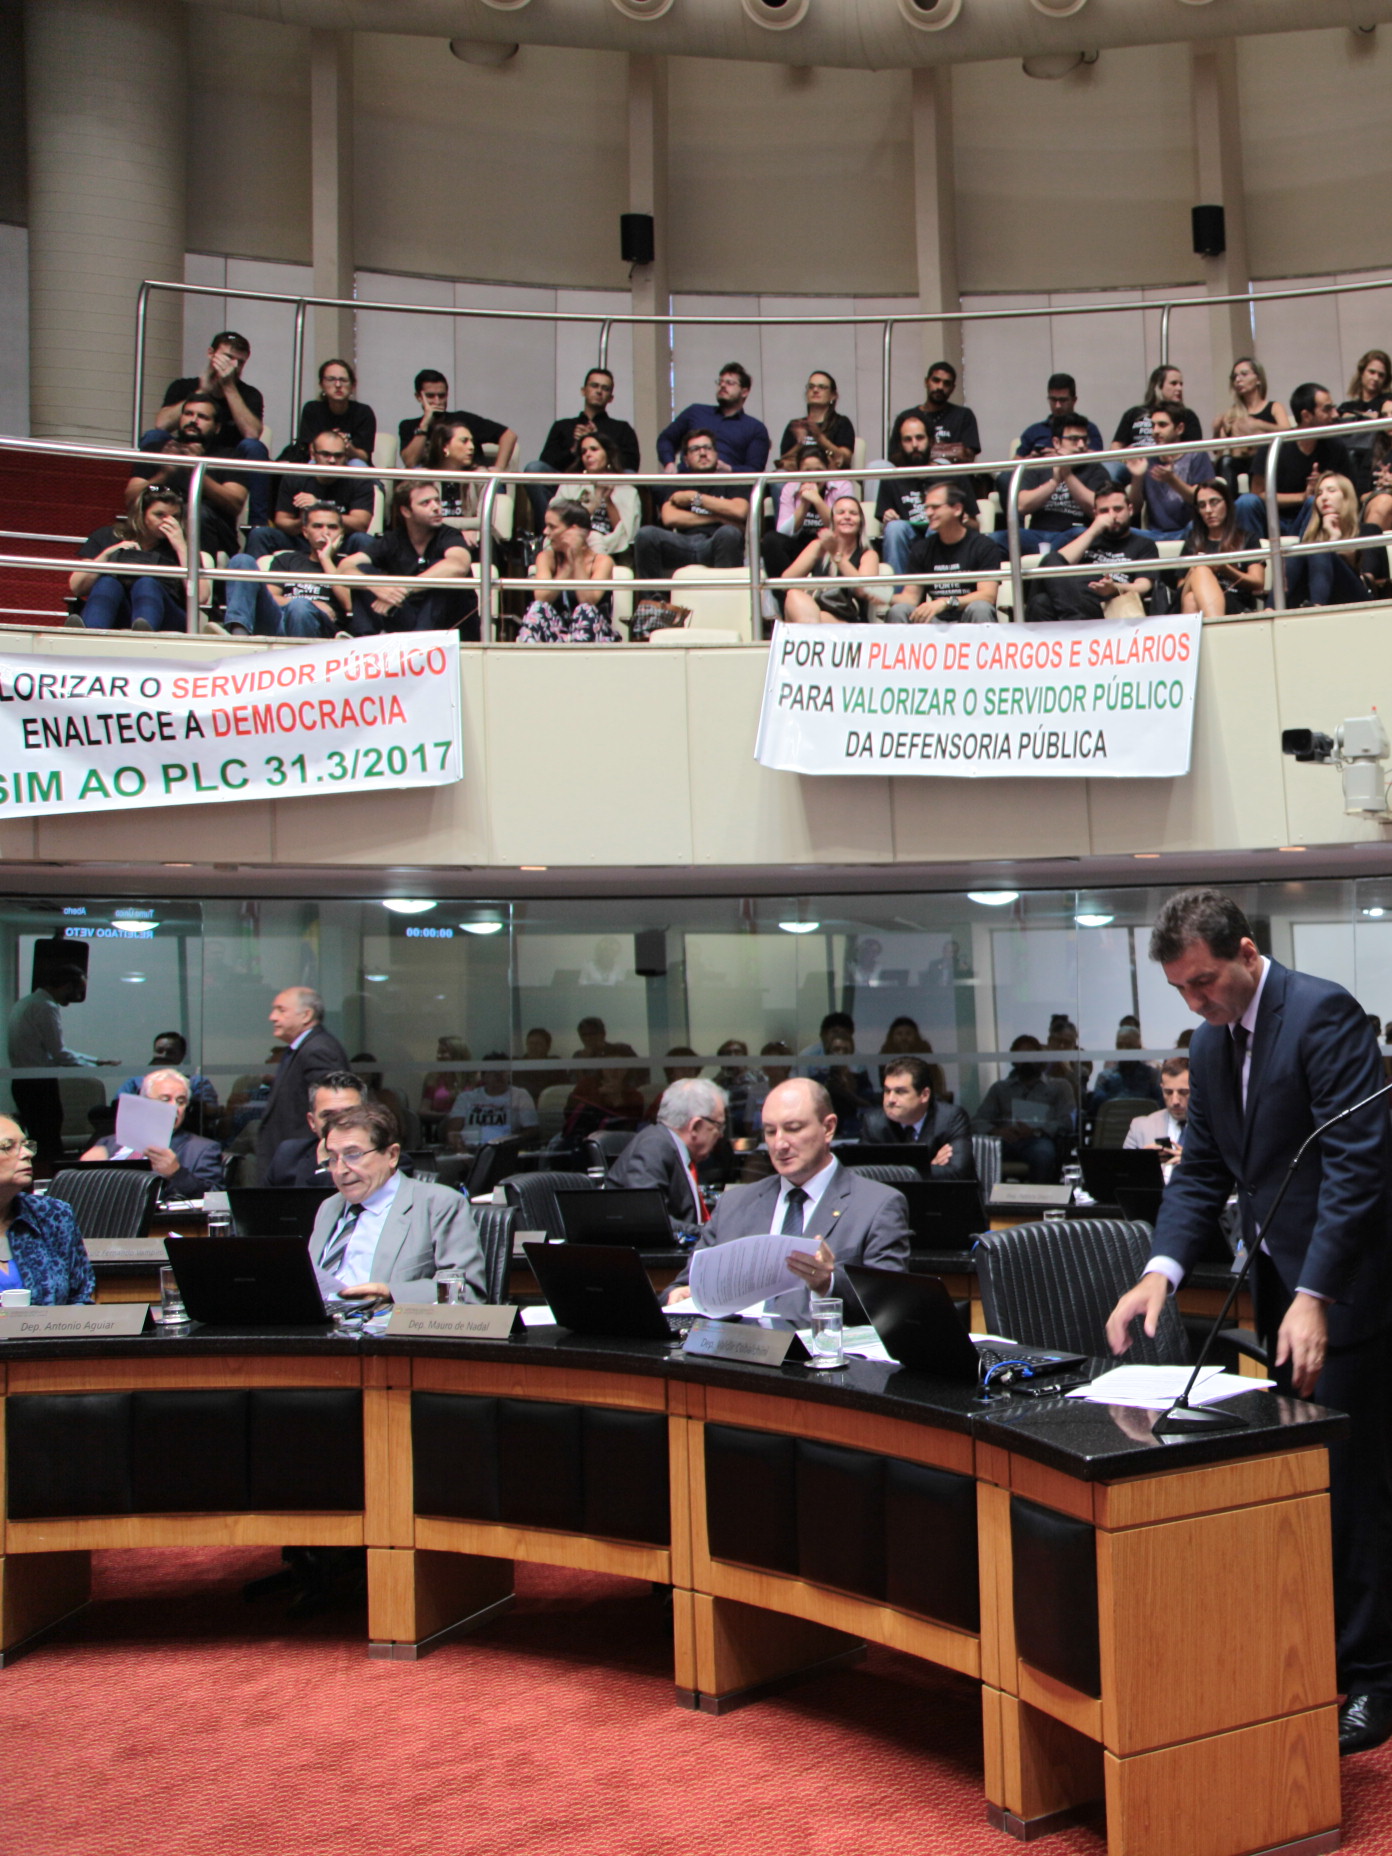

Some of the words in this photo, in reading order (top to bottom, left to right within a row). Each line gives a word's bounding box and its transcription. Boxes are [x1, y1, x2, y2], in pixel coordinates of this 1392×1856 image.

[780, 640, 824, 668] POR
[832, 641, 862, 669] UM
[867, 642, 937, 670] PLANO
[943, 642, 971, 670] DE
[976, 640, 1063, 671] CARGOS
[1069, 640, 1083, 668] E
[1087, 630, 1190, 666] SALÁRIOS
[139, 676, 162, 698] O
[172, 663, 315, 700] SERVIDOR
[324, 645, 447, 684] PÚBLICO
[779, 682, 834, 712] PARA
[841, 686, 956, 716] VALORIZAR
[963, 688, 979, 716] O
[983, 685, 1086, 716] SERVIDOR
[1092, 675, 1184, 712] PÚBLICO
[23, 711, 176, 749] ENALTECE
[185, 709, 204, 739] A
[212, 694, 407, 738] DEMOCRACIA
[845, 730, 874, 758] DA
[880, 730, 1012, 760] DEFENSORIA
[1017, 724, 1107, 760] PÚBLICA
[79, 766, 146, 800] AO
[163, 758, 249, 794] PLC
[264, 740, 454, 786] 31.3/2017
[21, 1322, 43, 1333] Dep.
[45, 1321, 82, 1331] Antonio
[84, 1321, 116, 1332] Aguiar
[428, 1321, 453, 1330] Mauro
[454, 1321, 464, 1330] de
[467, 1321, 490, 1331] Nadal
